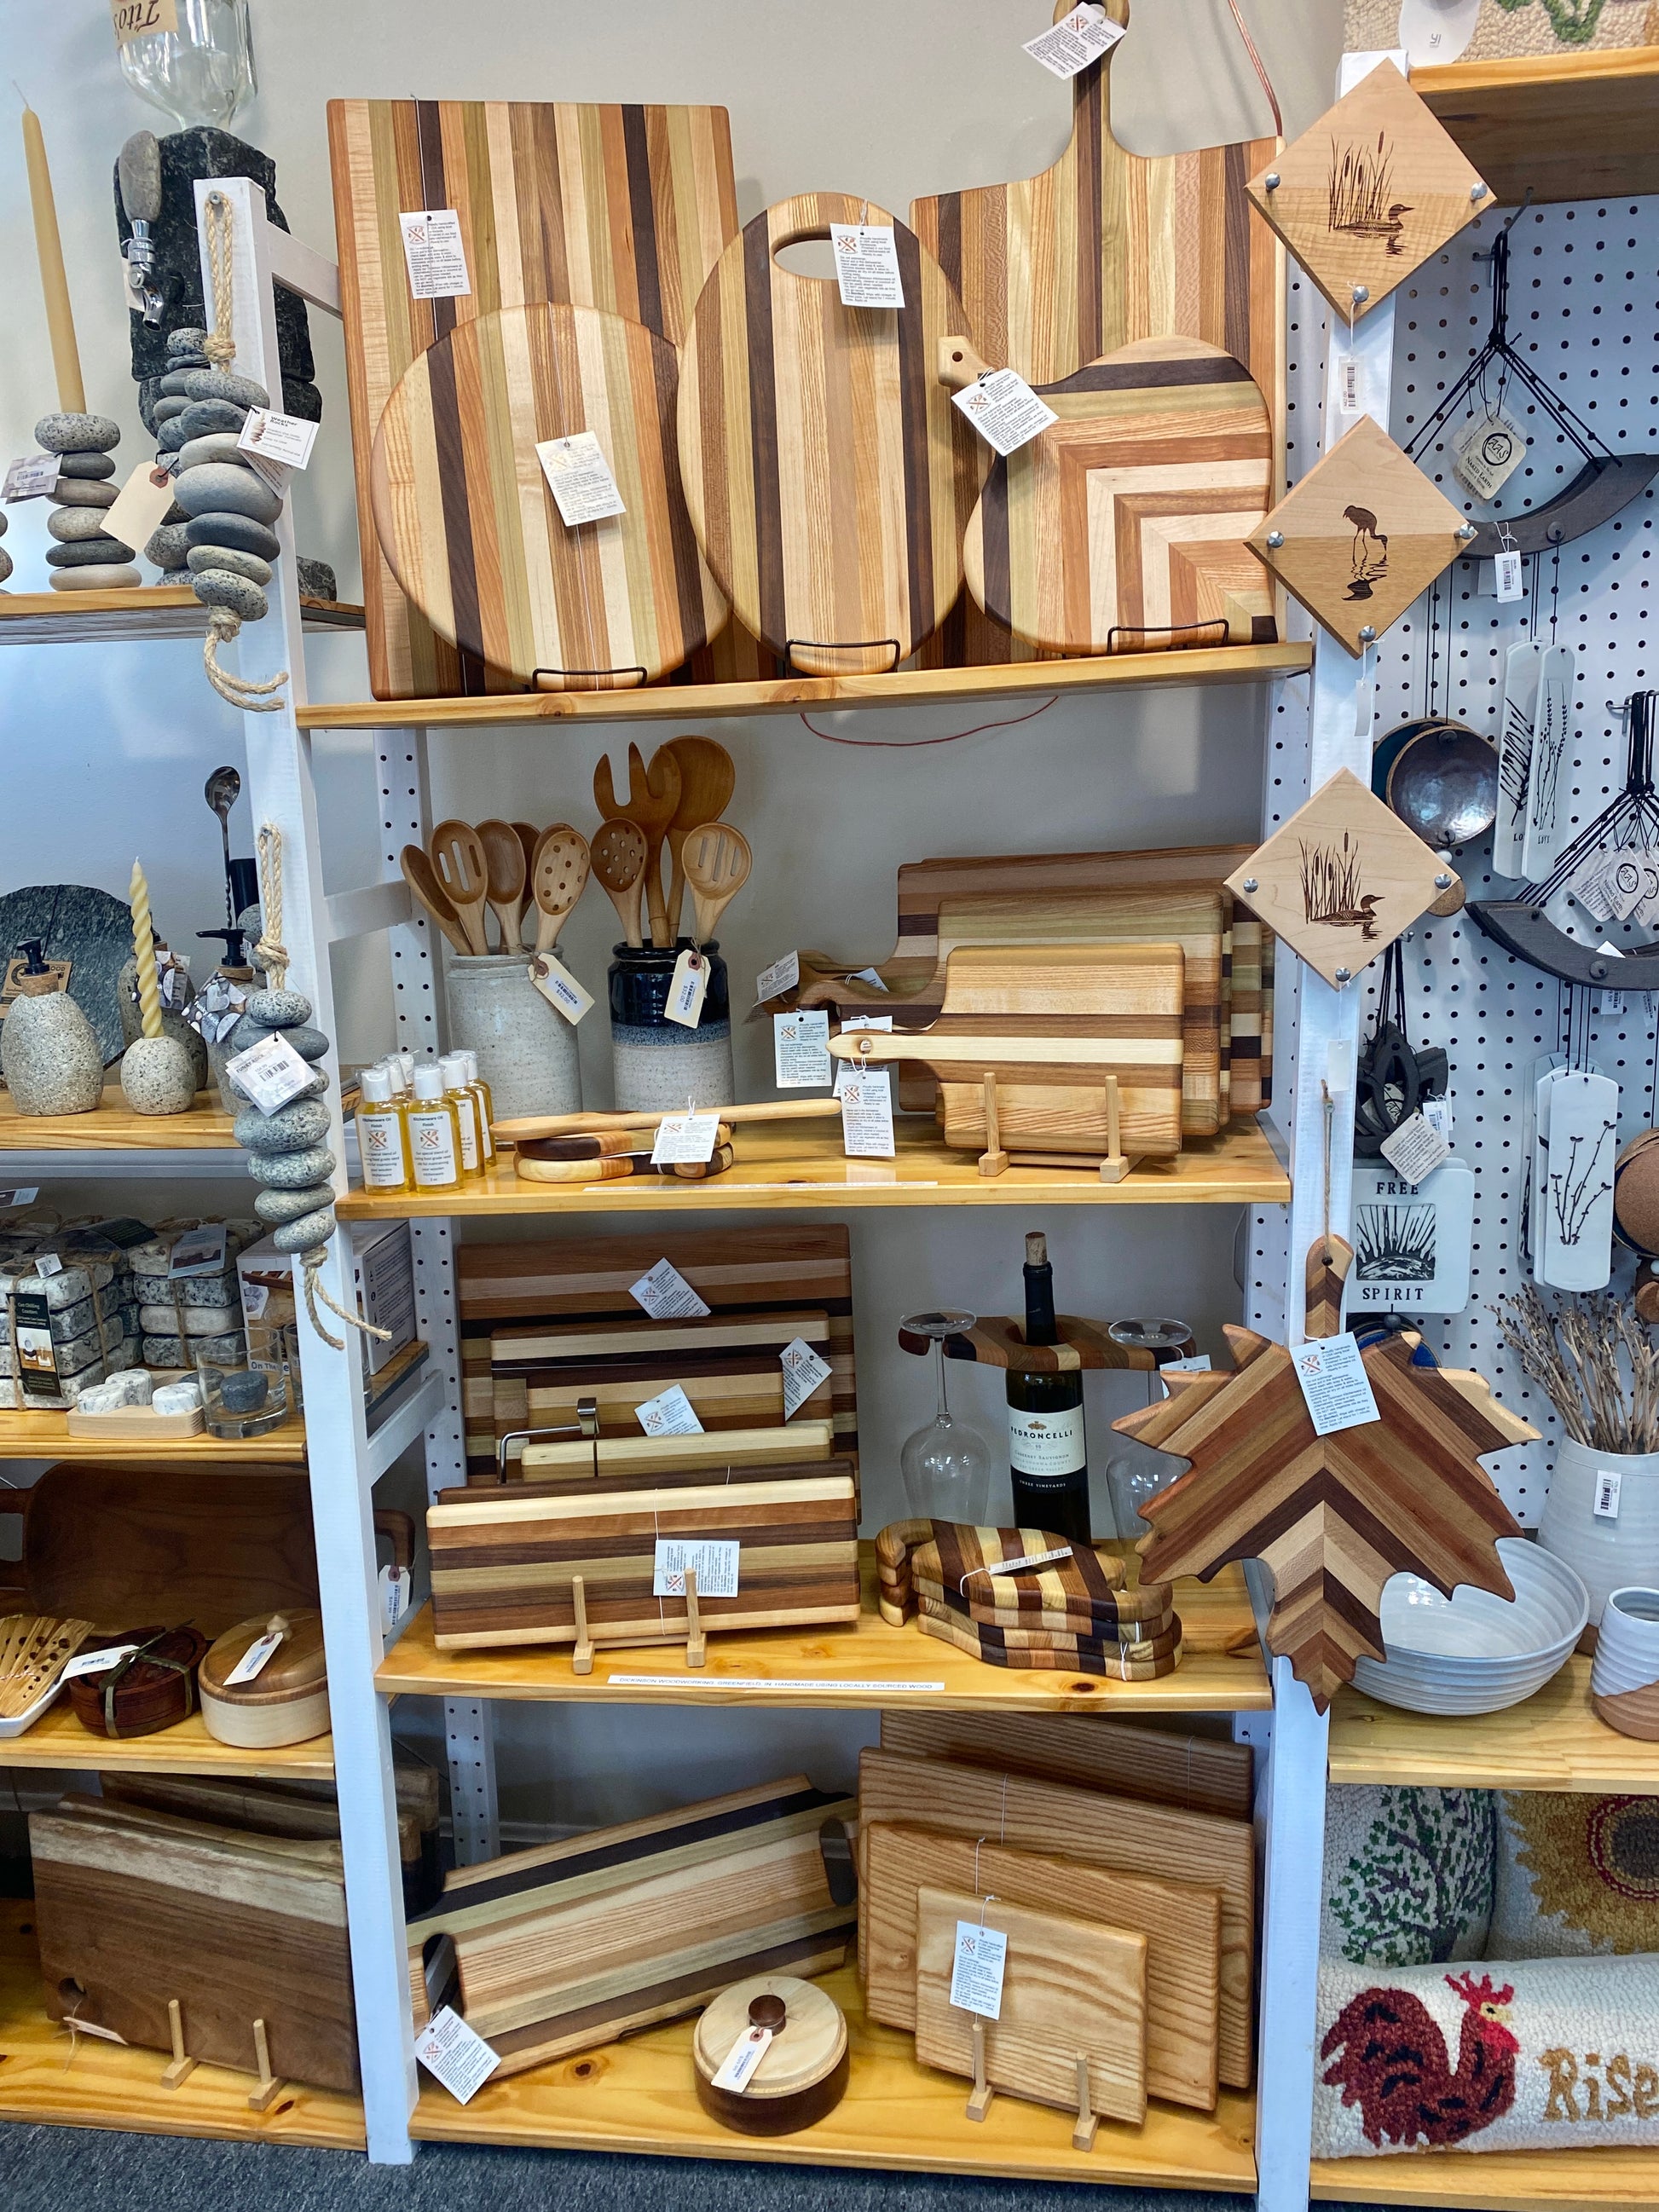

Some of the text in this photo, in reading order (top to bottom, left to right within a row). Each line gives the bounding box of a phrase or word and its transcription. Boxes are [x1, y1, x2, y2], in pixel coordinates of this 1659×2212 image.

[271, 416, 297, 426] Weather
[1377, 1182, 1419, 1194] FREE
[1362, 1288, 1424, 1300] SPIRIT
[1536, 2047, 1659, 2123] Rise
